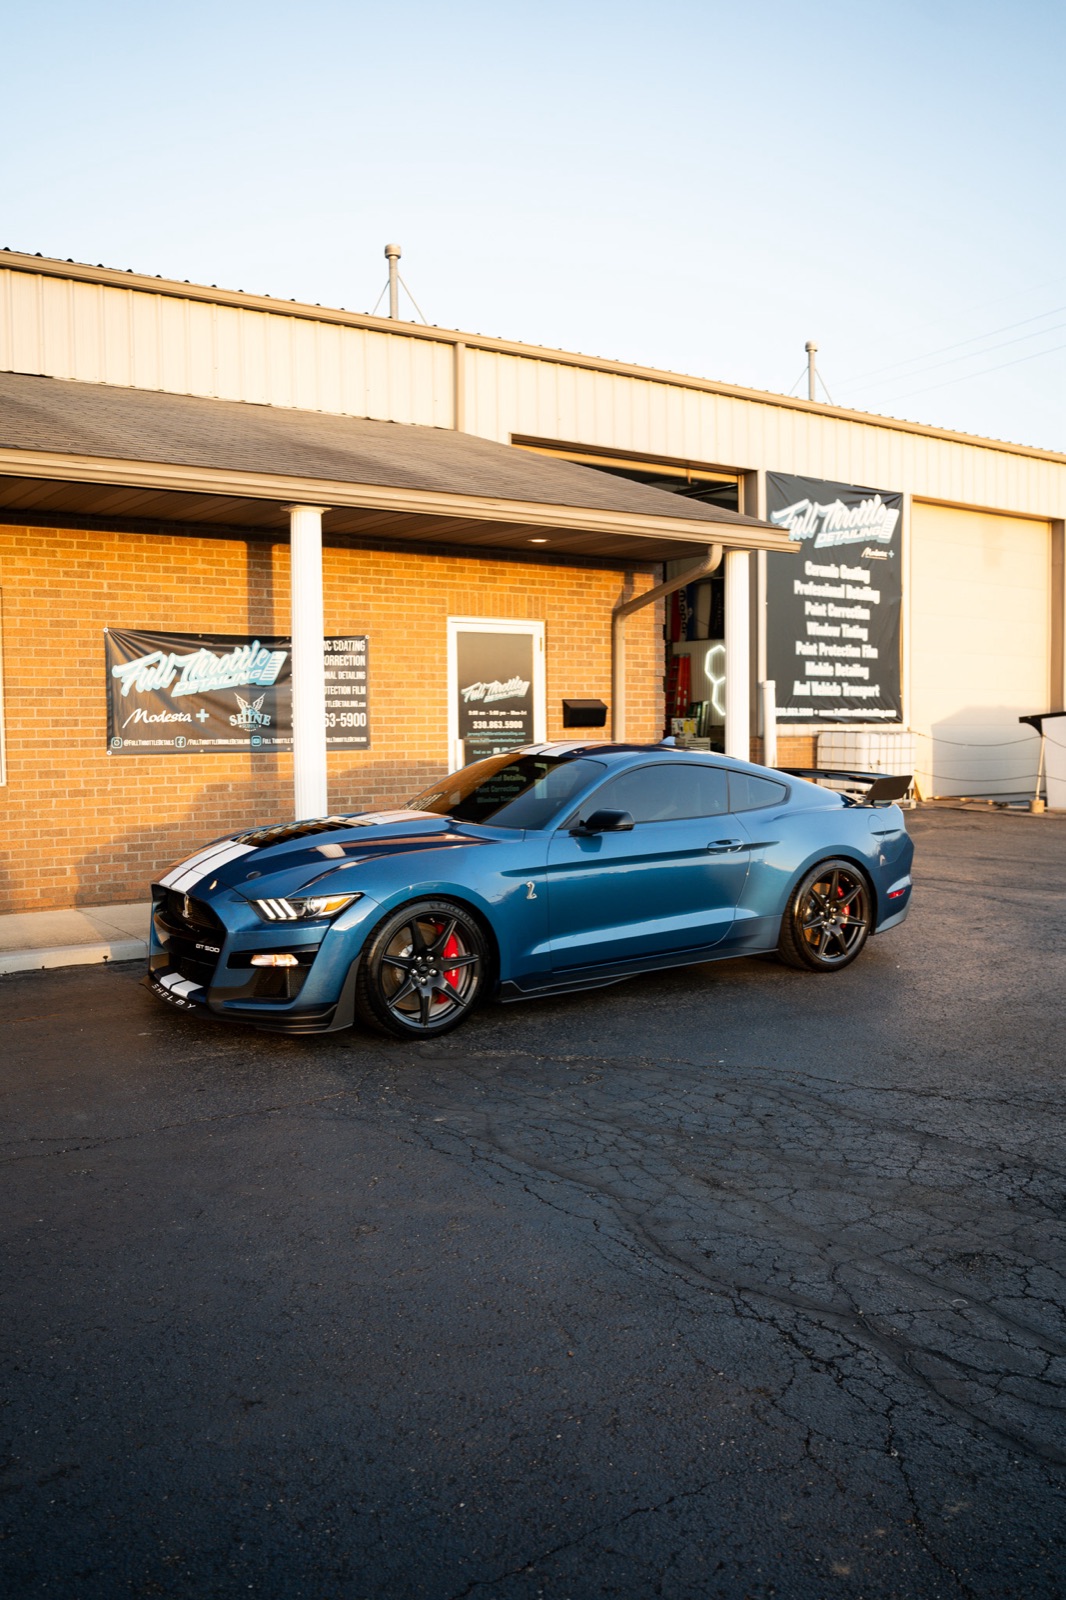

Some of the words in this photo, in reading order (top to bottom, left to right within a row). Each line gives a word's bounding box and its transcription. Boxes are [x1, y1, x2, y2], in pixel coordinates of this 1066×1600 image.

[770, 498, 819, 541] Full
[816, 494, 887, 533] Throttle
[814, 526, 882, 547] DETAILING
[805, 560, 839, 578] Ceramic
[840, 564, 870, 584] Coating
[793, 579, 845, 599] Professional
[846, 584, 880, 604] Detailing
[805, 600, 827, 617] Paint
[828, 602, 870, 620] Correction
[806, 621, 840, 637] Window
[841, 623, 868, 641] Tinting
[333, 640, 366, 652] COATING
[795, 640, 818, 655] Paint
[818, 642, 861, 658] Protection
[861, 644, 878, 659] Film
[112, 651, 177, 697] Full
[172, 640, 270, 682] Throttle
[324, 655, 366, 666] ORRECTION
[805, 661, 834, 676] Mobile
[835, 662, 869, 680] Detailing
[172, 669, 262, 695] DETAILING
[338, 671, 366, 680] DETAILING
[352, 685, 366, 695] FILM
[461, 682, 486, 703] Full
[485, 675, 523, 696] Throttle
[793, 680, 811, 696] And
[811, 680, 841, 696] Vehicle
[841, 682, 880, 699] Transport
[122, 708, 192, 728] Modesta
[229, 712, 272, 727] SHINE
[472, 720, 523, 729] 330.863.5900
[152, 983, 197, 1009] SHELBY
